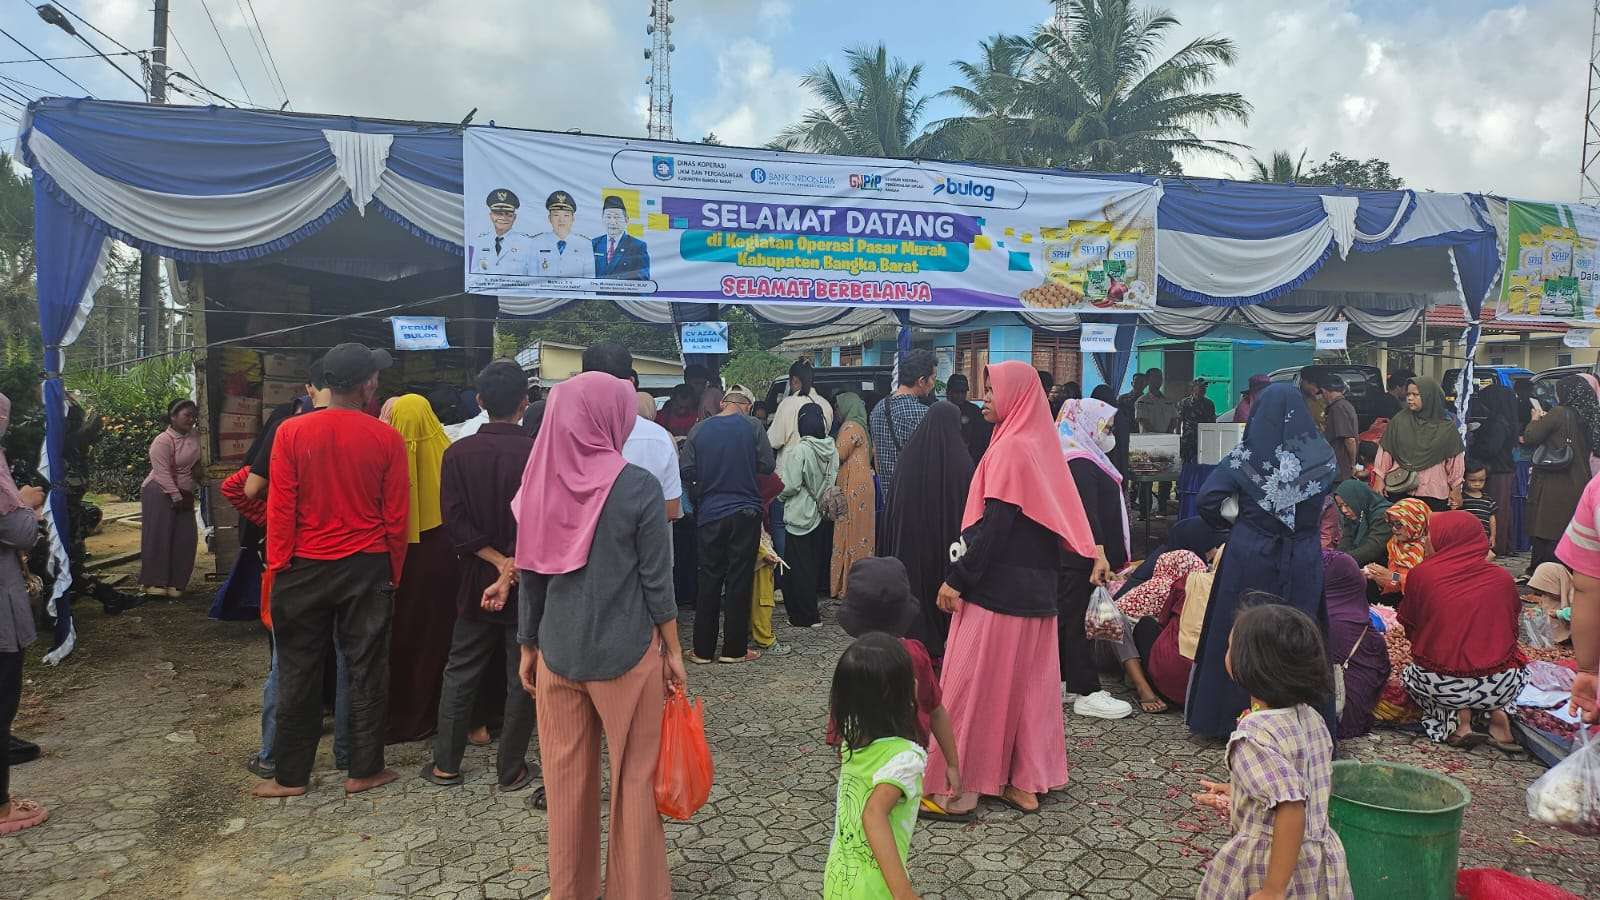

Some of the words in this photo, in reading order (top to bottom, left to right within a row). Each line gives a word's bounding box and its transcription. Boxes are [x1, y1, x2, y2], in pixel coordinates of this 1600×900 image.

[769, 173, 789, 182] BANK
[792, 175, 836, 185] INDONESIA
[947, 177, 995, 201] bulog
[702, 203, 836, 233] SELAMAT
[846, 211, 954, 238] DATANG
[707, 233, 722, 247] di
[726, 233, 793, 252] Kegiatan
[797, 235, 854, 254] Operasi
[857, 238, 897, 254] Pasar
[901, 241, 947, 257] Murah
[1081, 245, 1106, 254] SPHP
[1113, 250, 1135, 259] SPHP
[737, 252, 820, 271] Kabupaten
[824, 256, 877, 275] Bangka
[880, 258, 919, 273] Barat
[722, 276, 812, 298] SELAMAT
[815, 280, 932, 301] BERBELANJA
